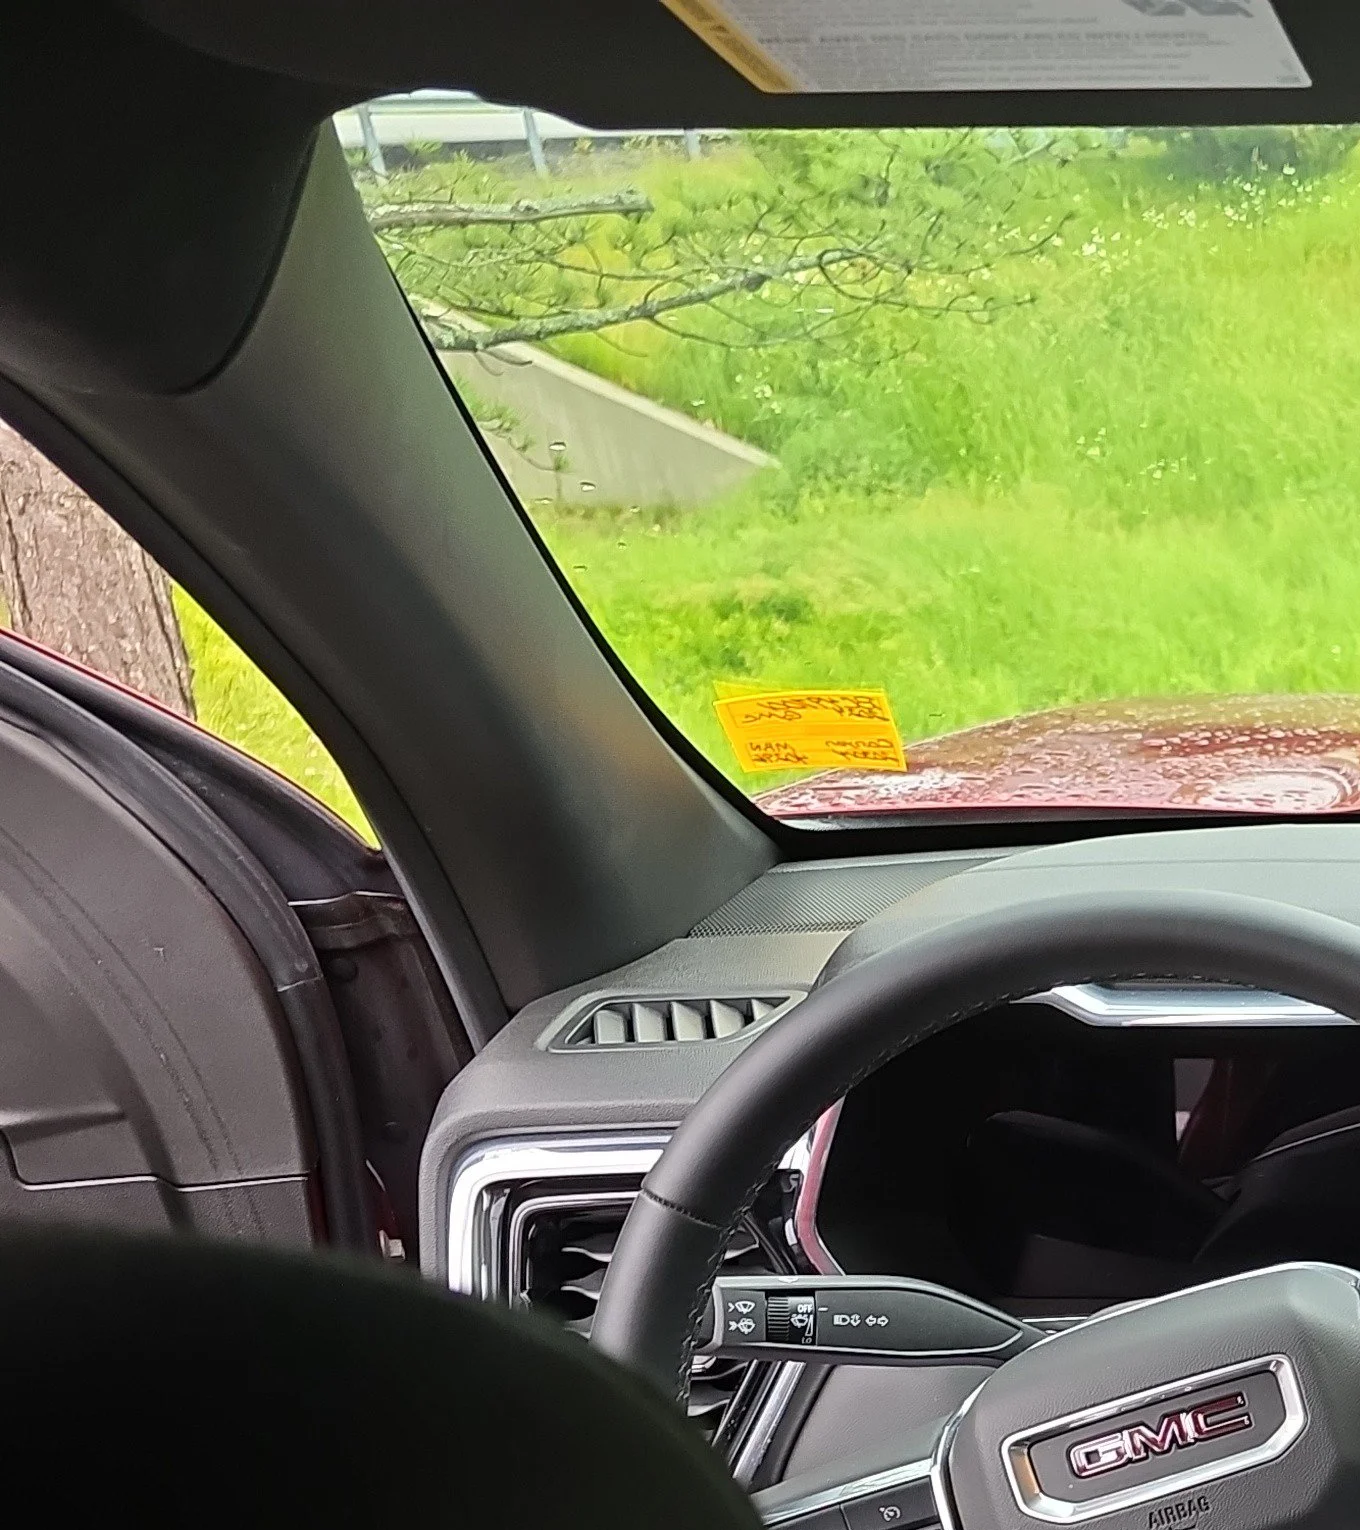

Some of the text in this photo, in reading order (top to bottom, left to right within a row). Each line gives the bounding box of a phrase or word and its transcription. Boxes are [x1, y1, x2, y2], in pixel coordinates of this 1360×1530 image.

[797, 1304, 814, 1313] OFF
[1069, 1392, 1253, 1480] GMC
[1147, 1495, 1211, 1530] AIRBAG
